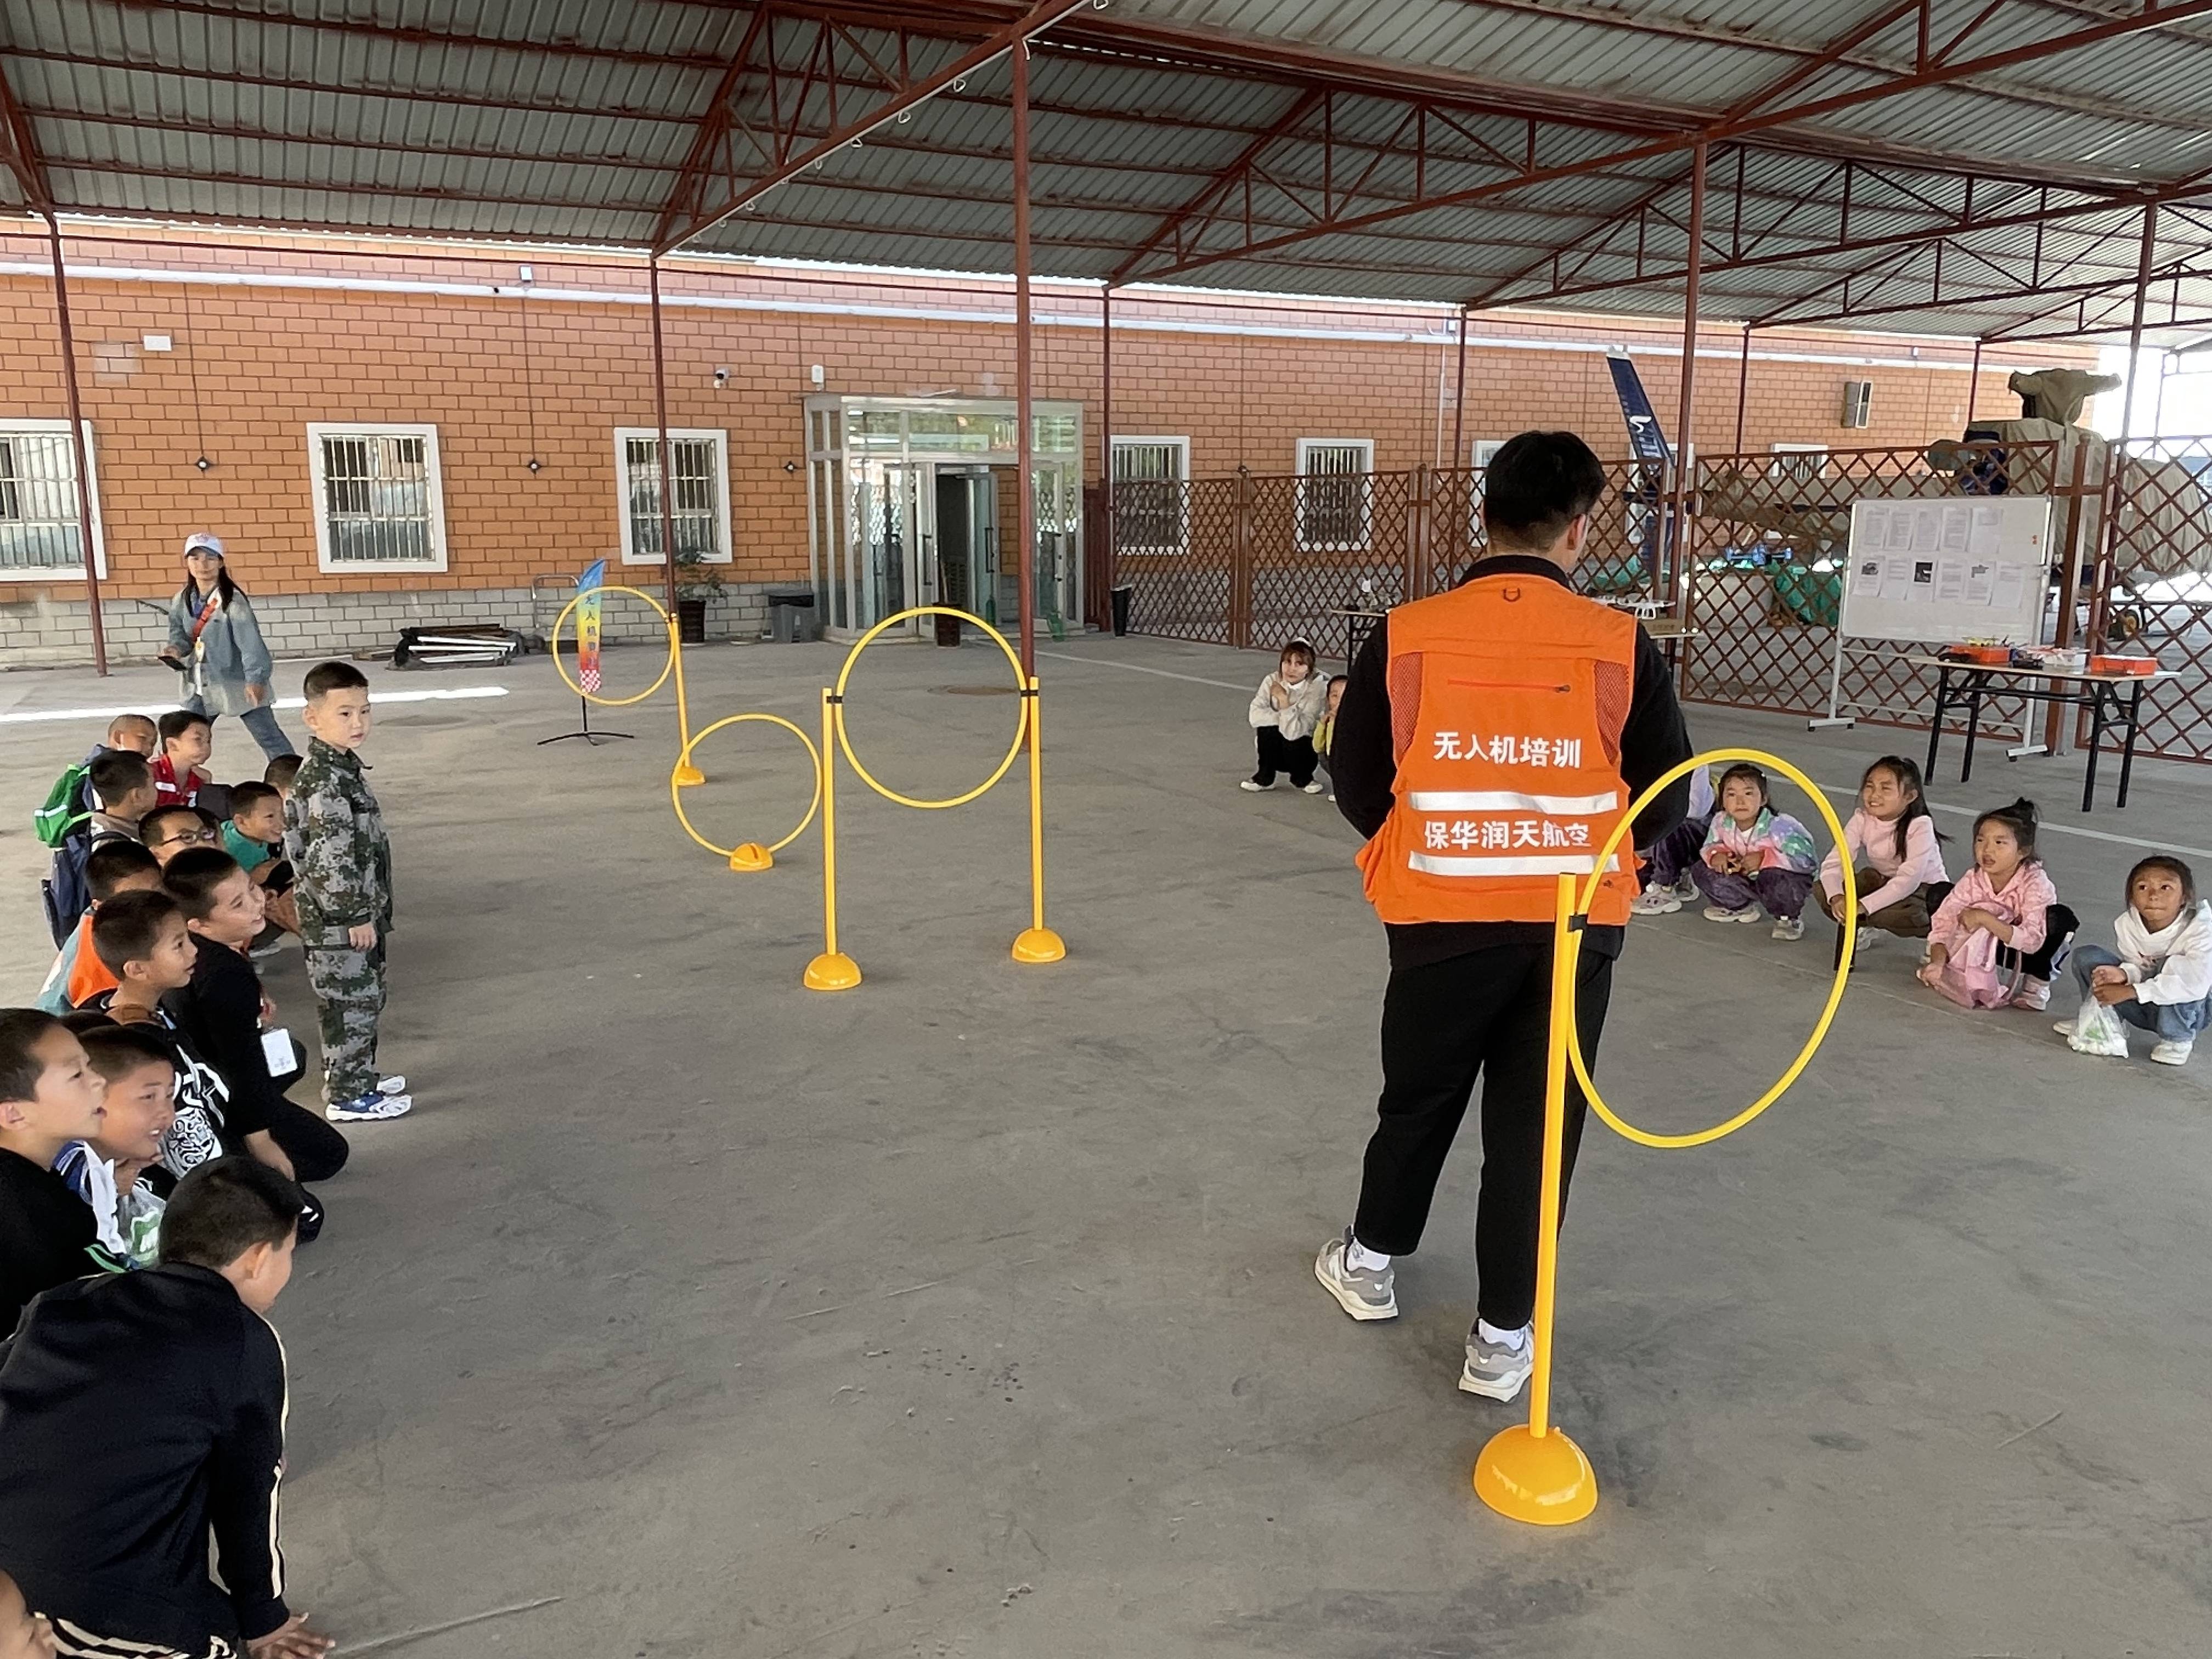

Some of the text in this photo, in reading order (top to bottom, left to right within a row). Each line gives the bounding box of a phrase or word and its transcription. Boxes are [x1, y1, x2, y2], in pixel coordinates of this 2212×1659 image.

[1433, 732, 1581, 768] 无人机培训
[1424, 820, 1592, 850] 保华润天航空
